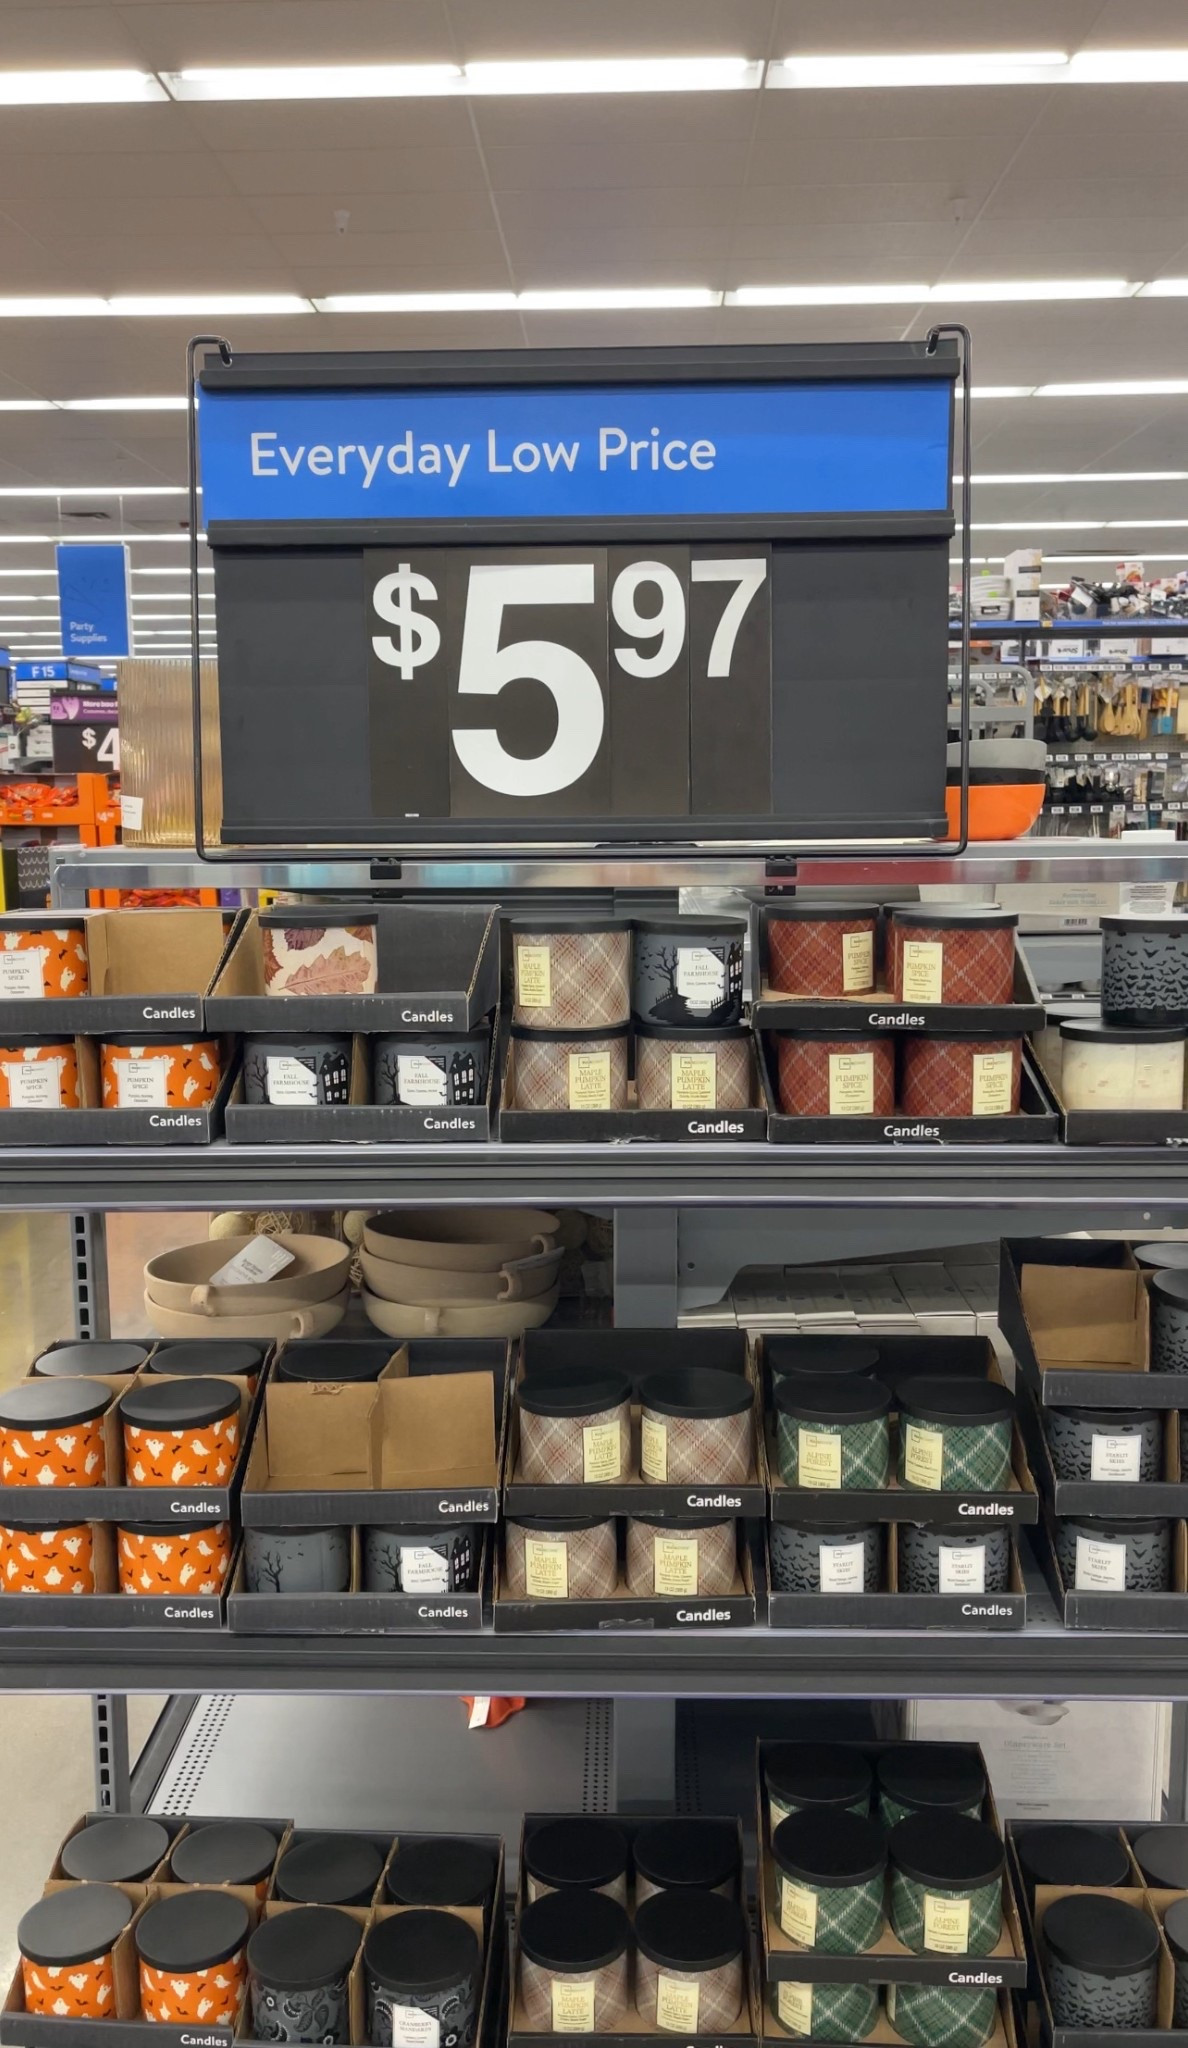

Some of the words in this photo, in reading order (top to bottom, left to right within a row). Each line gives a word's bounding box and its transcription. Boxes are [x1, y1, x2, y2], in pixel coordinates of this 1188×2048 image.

[251, 430, 471, 489] Everyday
[487, 430, 580, 473] Low
[599, 427, 717, 472] Price
[70, 622, 94, 632] Party
[70, 634, 107, 643] Supplies
[906, 963, 936, 971] PUMPKIN
[911, 970, 930, 978] SPICE
[142, 1007, 196, 1019] Candles
[401, 1010, 454, 1023] Candles
[868, 1013, 925, 1026] Candles
[579, 1069, 603, 1077] MAPLE
[681, 1069, 707, 1077] MAPLE
[979, 1073, 1008, 1082] PUMPKIN
[575, 1076, 606, 1084] PUMPKIN
[676, 1076, 711, 1084] PUMPKIN
[835, 1074, 869, 1082] PUMPKIN
[580, 1082, 602, 1090] LATTE
[682, 1083, 706, 1091] LATTE
[842, 1081, 864, 1089] SPICE
[985, 1081, 1004, 1089] SPICE
[149, 1115, 202, 1127] Candles
[423, 1117, 476, 1130] Candles
[687, 1120, 745, 1134] Candles
[883, 1124, 940, 1137] Candles
[592, 1438, 614, 1447] MAPLE
[589, 1444, 617, 1456] PUMPKIN
[594, 1452, 614, 1461] LATTE
[806, 1451, 832, 1459] ALPINE
[806, 1458, 833, 1467] FOREST
[686, 1495, 742, 1508] Candles
[170, 1502, 221, 1513] Candles
[438, 1500, 490, 1513] Candles
[958, 1503, 1015, 1516] Candles
[534, 1556, 557, 1564] MAPLE
[664, 1553, 688, 1561] MAPLE
[530, 1562, 562, 1571] PUMPKIN
[659, 1560, 692, 1569] PUMPKIN
[664, 1567, 688, 1575] LATTE
[164, 1607, 214, 1619] Candles
[417, 1606, 469, 1618] Candles
[961, 1604, 1013, 1616] Candles
[676, 1609, 731, 1622] Candles
[933, 1917, 960, 1925] ALPINE
[948, 1972, 1003, 1984] Candles
[666, 2004, 687, 2014] LATTE
[180, 2034, 228, 2047] Candles
